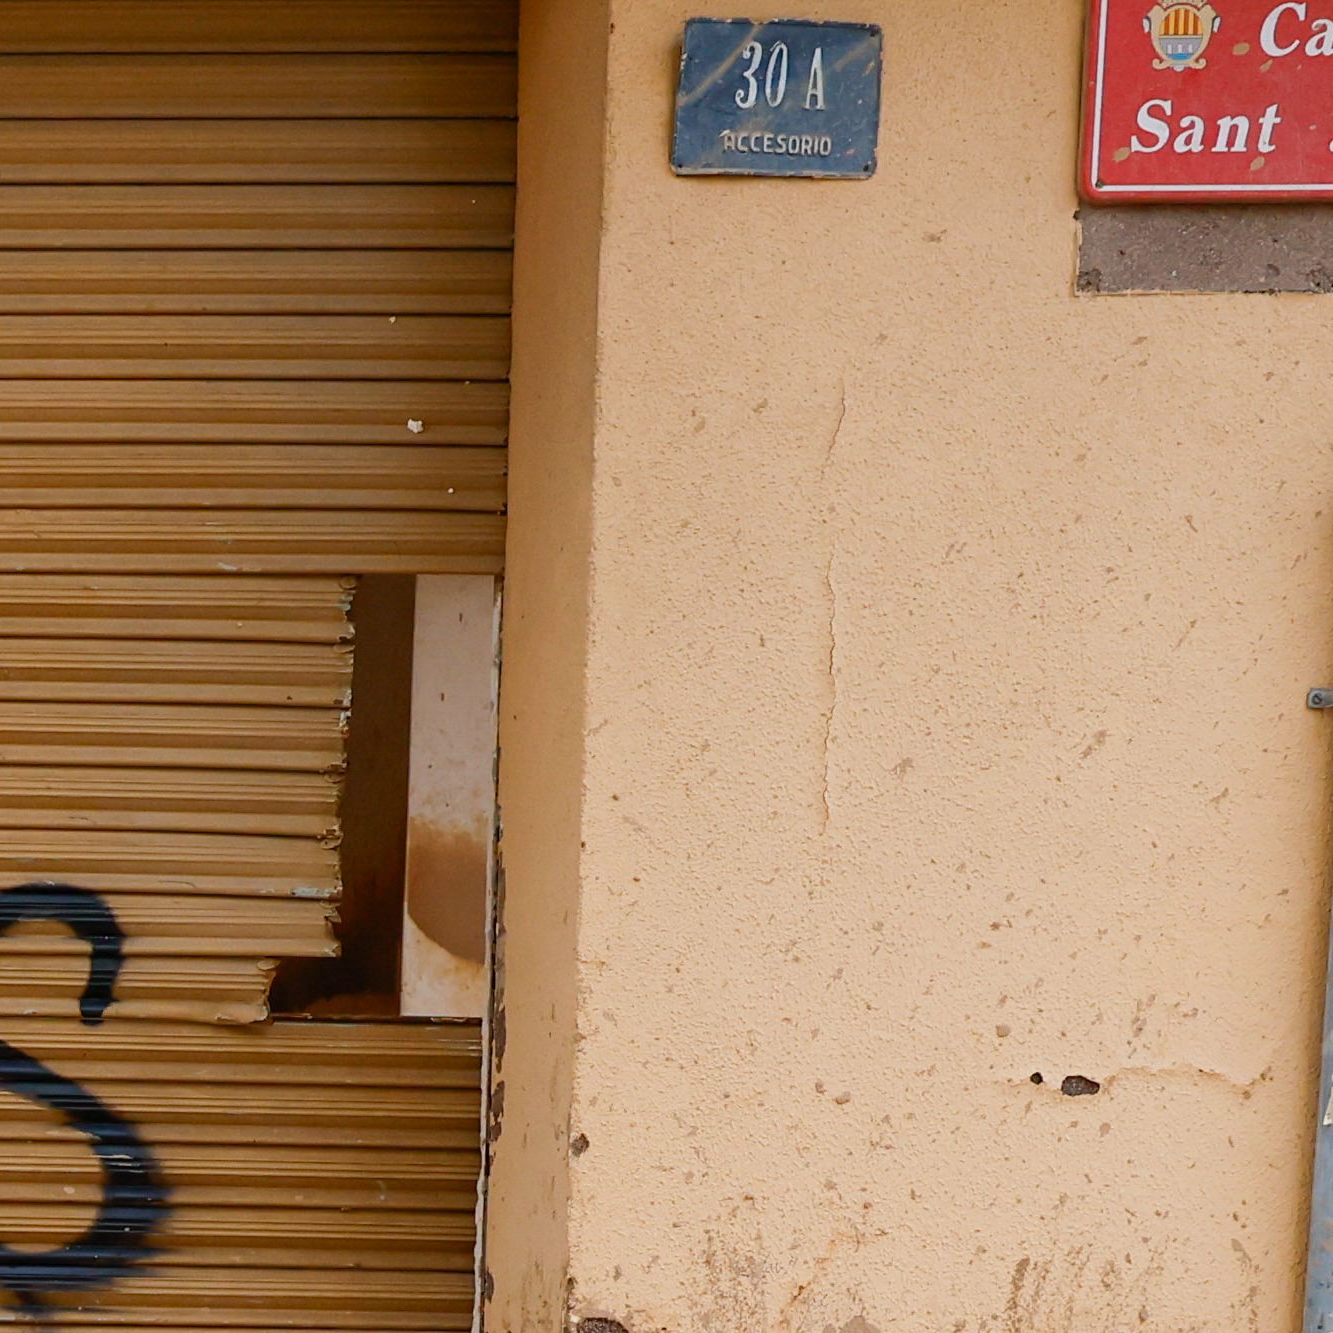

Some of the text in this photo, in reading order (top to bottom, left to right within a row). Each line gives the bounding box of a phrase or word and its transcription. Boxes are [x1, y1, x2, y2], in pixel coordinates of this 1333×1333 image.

[735, 40, 826, 111] 30 A
[722, 131, 831, 157] ACCESORIO
[1130, 98, 1282, 153] Sant
